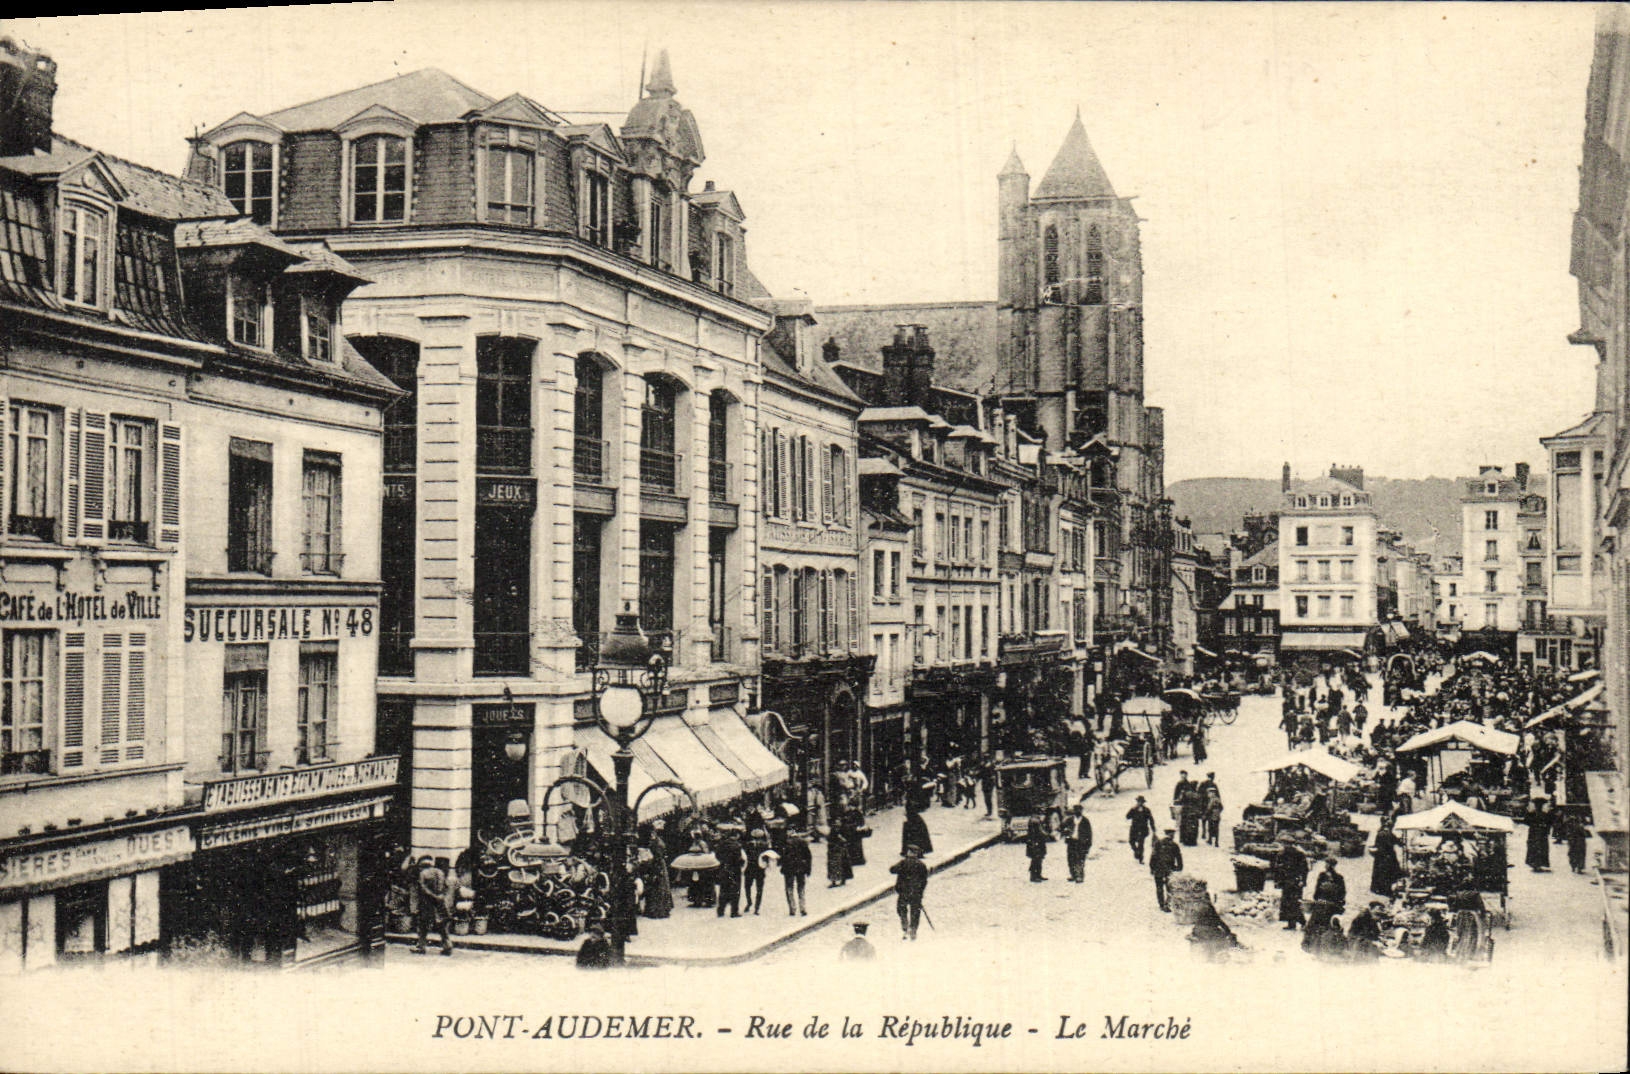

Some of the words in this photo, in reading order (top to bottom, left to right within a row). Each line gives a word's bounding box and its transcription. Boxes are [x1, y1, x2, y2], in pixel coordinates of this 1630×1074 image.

[488, 484, 523, 499] JEUX
[0, 590, 35, 621] CAFÉ
[38, 601, 53, 620] de
[110, 600, 126, 619] de
[126, 590, 161, 619] VILLE
[184, 607, 311, 642] SUCCURSALE
[346, 608, 373, 638] 48
[263, 820, 292, 837] VINS
